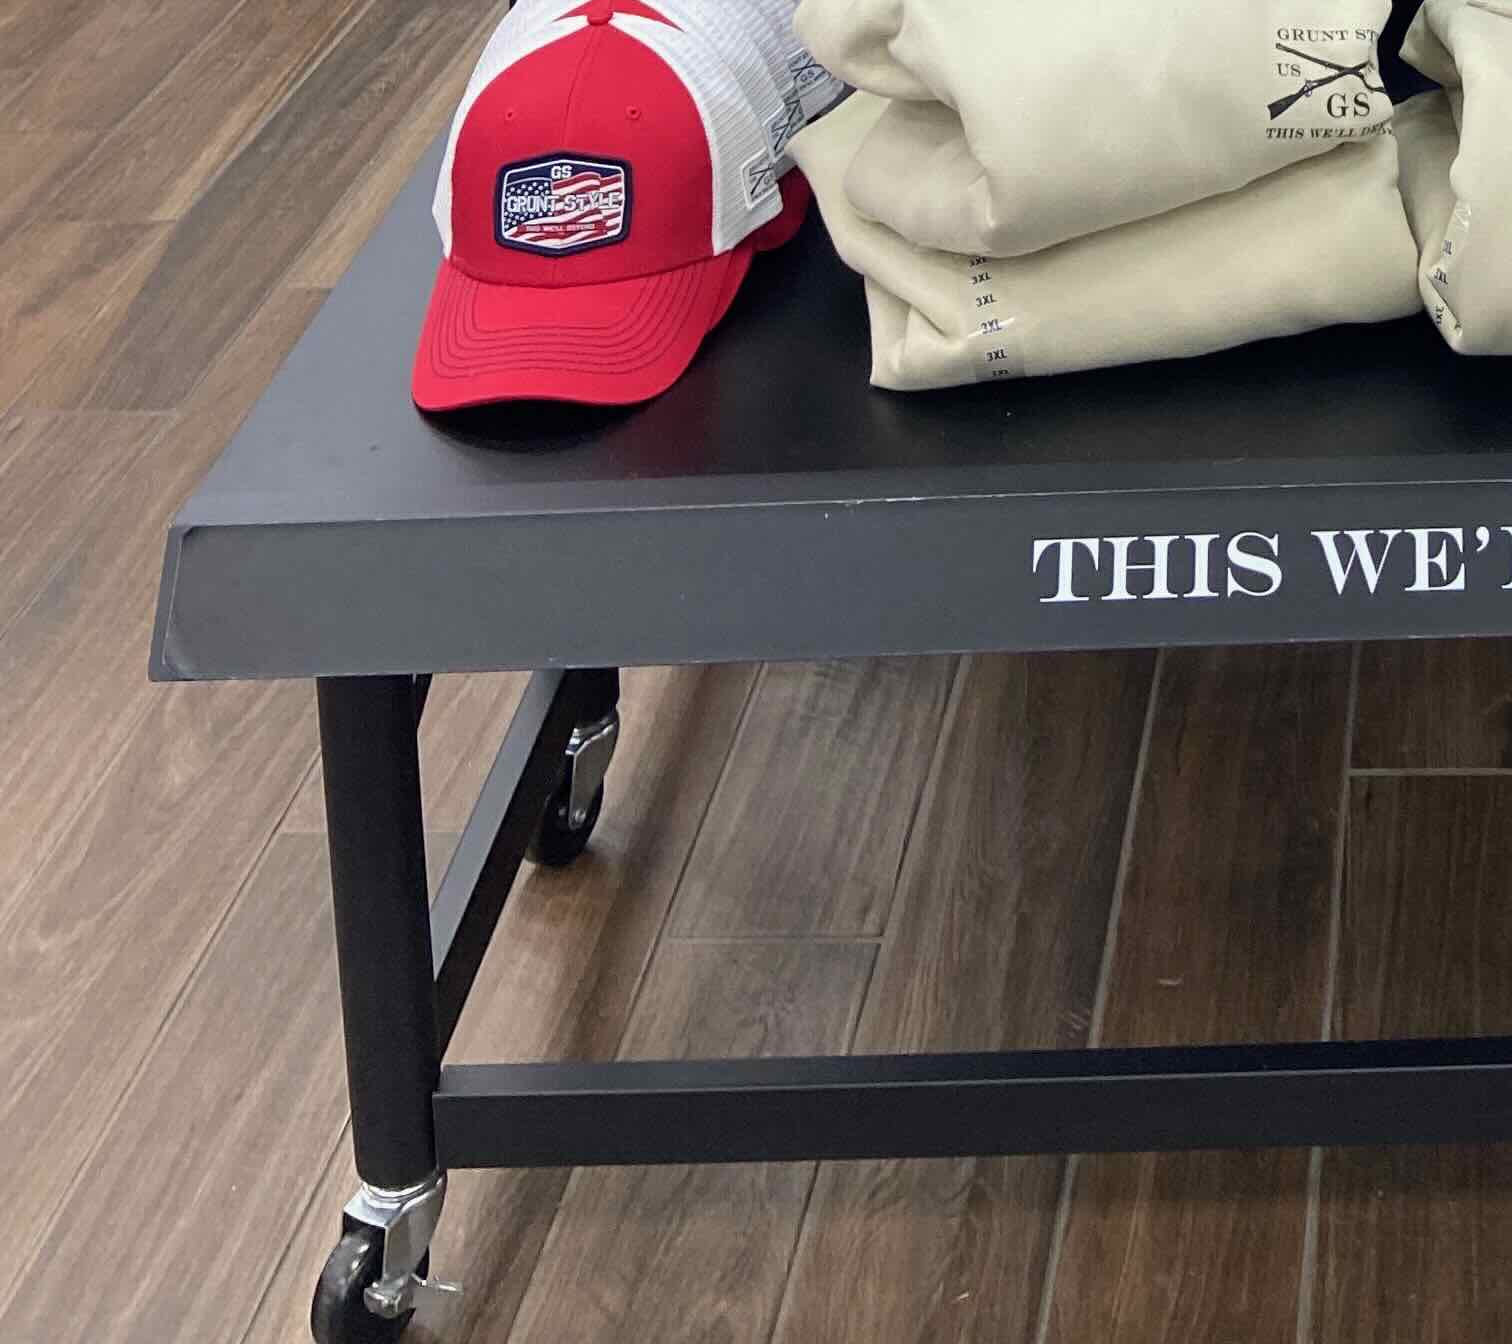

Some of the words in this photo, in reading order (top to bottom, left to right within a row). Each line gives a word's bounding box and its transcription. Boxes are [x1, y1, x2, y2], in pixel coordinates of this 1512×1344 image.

[1276, 28, 1349, 42] GRUNT
[1276, 63, 1301, 77] US
[1326, 92, 1370, 118] GS
[1266, 127, 1304, 139] THIS
[551, 165, 573, 179] GS
[506, 194, 557, 213] GRUNT
[564, 191, 621, 212] STYLE
[972, 272, 992, 285] 3XL
[976, 294, 997, 307] 3XL
[986, 349, 1008, 362] 3XL
[1032, 532, 1283, 603] THIS
